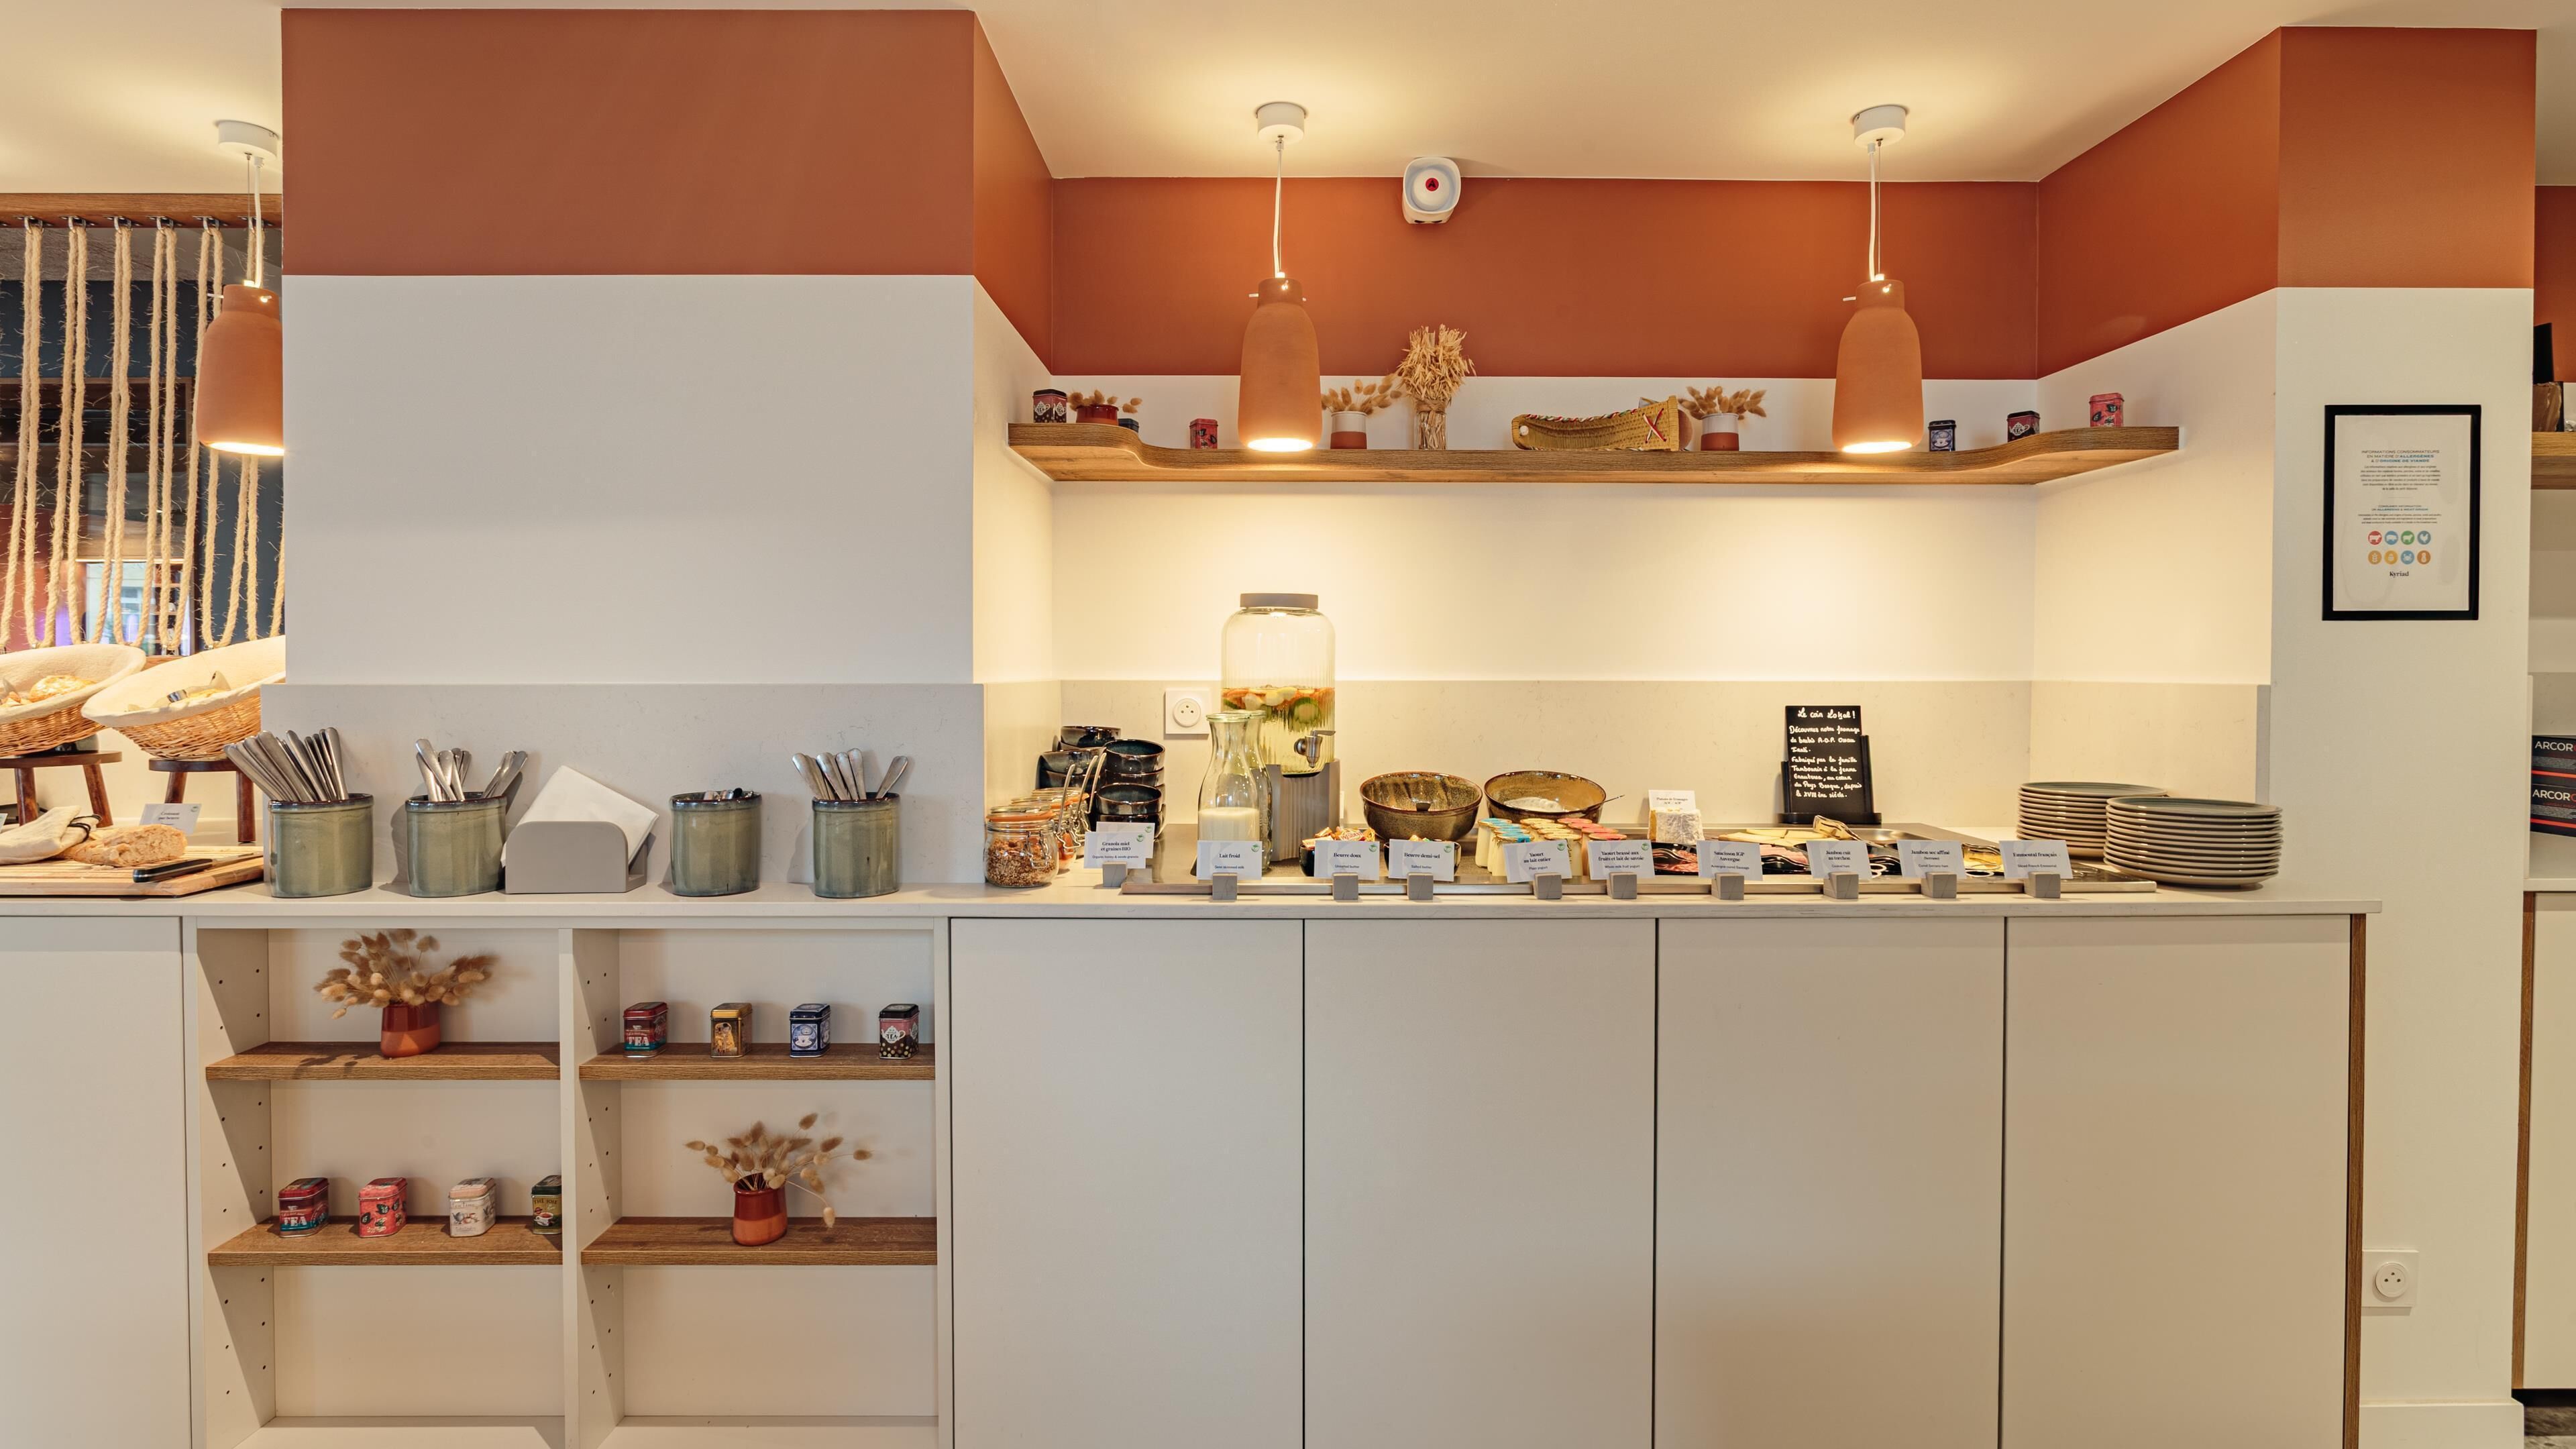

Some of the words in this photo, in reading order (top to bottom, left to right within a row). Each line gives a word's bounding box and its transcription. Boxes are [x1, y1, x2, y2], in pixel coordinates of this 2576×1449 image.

[1837, 725, 1860, 735] fromage
[1838, 757, 1858, 765] famille
[1839, 767, 1857, 775] ferme
[1803, 781, 1817, 790] Pays
[1844, 782, 1862, 790] depuis
[627, 1036, 649, 1046] TEA
[282, 1216, 307, 1226] TEA
